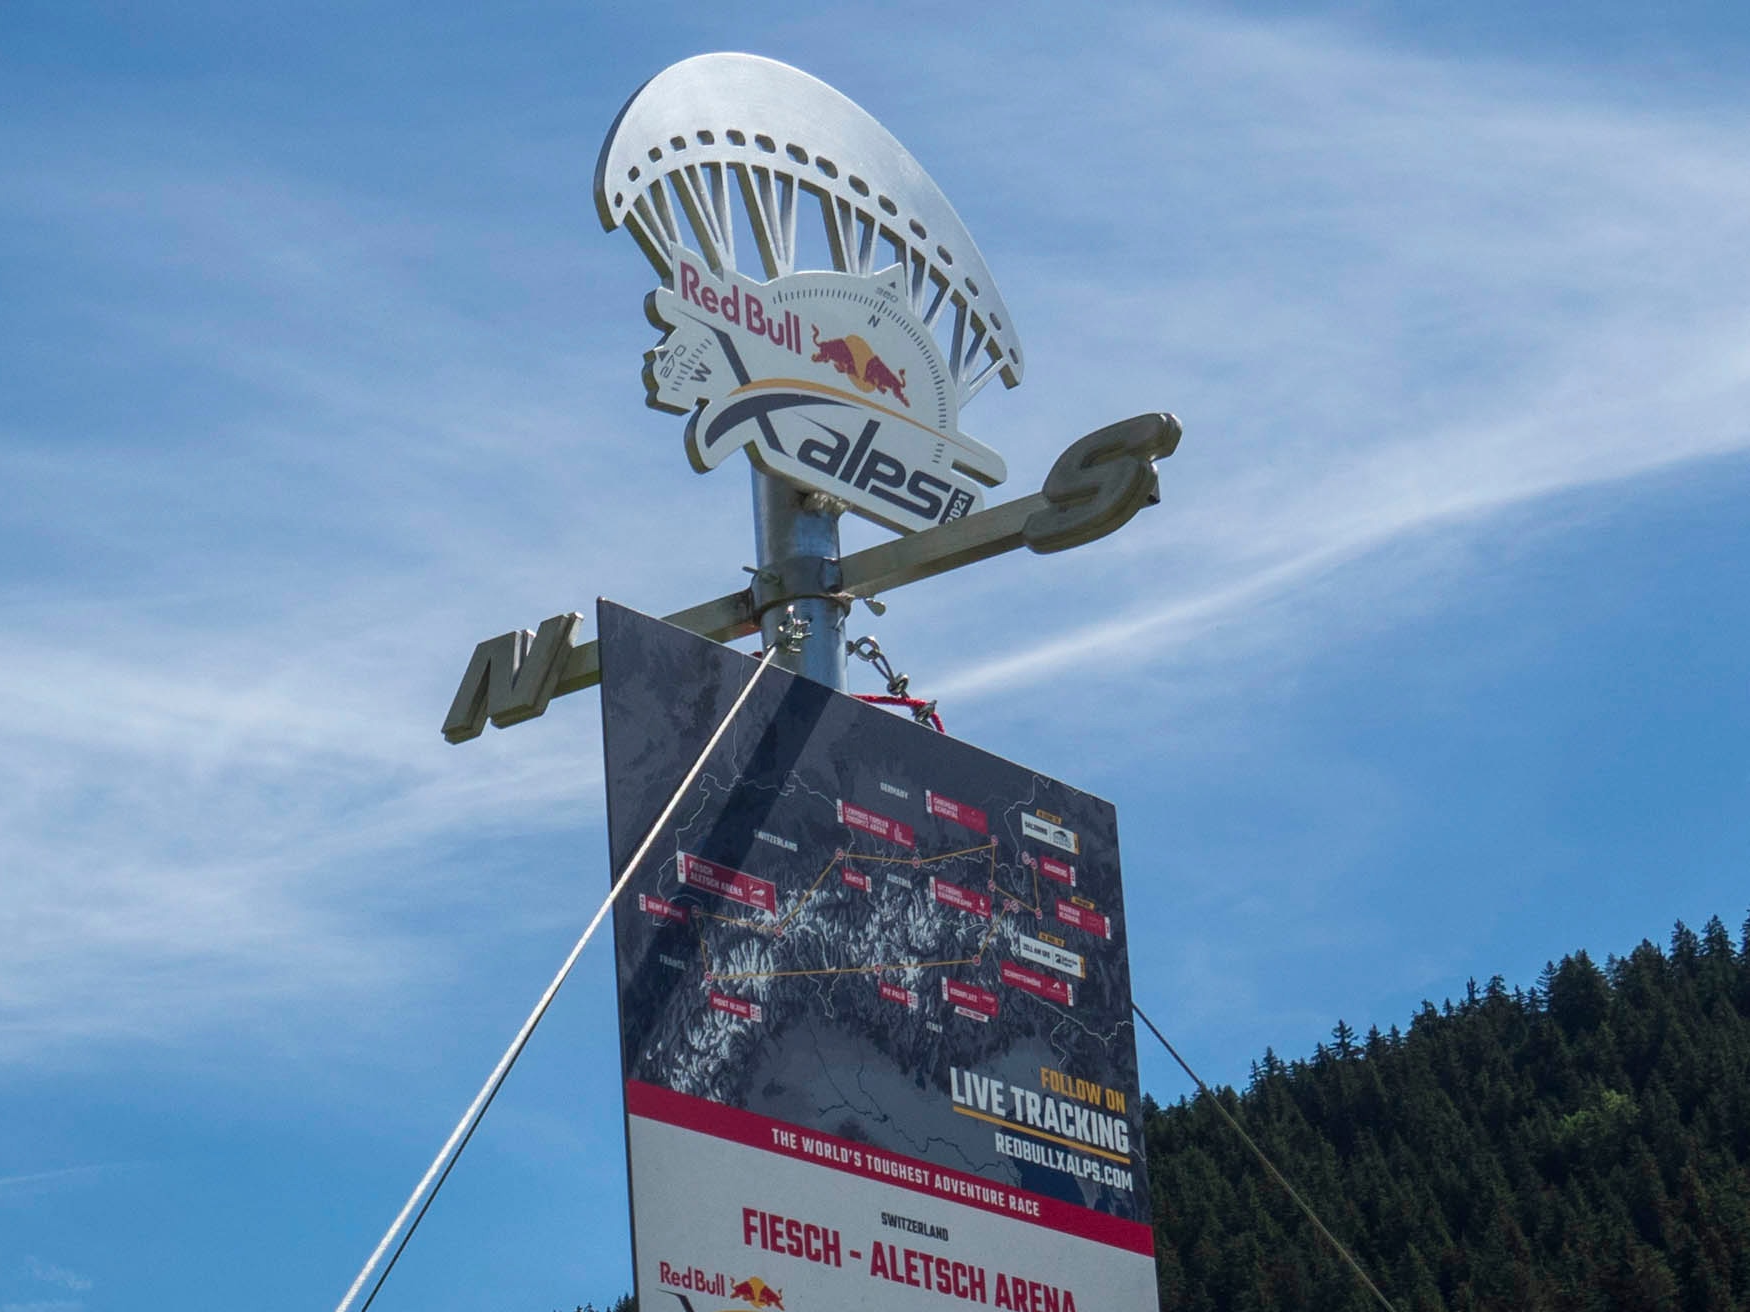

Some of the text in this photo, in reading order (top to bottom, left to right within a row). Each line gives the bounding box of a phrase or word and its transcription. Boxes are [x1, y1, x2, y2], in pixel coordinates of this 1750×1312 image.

[679, 261, 802, 355] Red Bull
[867, 314, 880, 328] N
[660, 344, 687, 379] 270
[690, 362, 712, 383] W
[1023, 413, 1182, 554] S
[441, 612, 584, 745] N
[949, 1065, 1130, 1155] LIVE TRACKING
[1039, 1065, 1126, 1115] FOLLOW ON
[771, 1126, 1040, 1218] THE WORLD'S TOUGHEST ADVENTURE RACE
[994, 1130, 1134, 1193] REDBULLXALPS.COM
[741, 1205, 842, 1269] FIESCH
[848, 1248, 862, 1260] -
[866, 1237, 987, 1304] ALETSCH
[880, 1210, 949, 1242] SWITZERLAND
[658, 1259, 725, 1298] Red Bull
